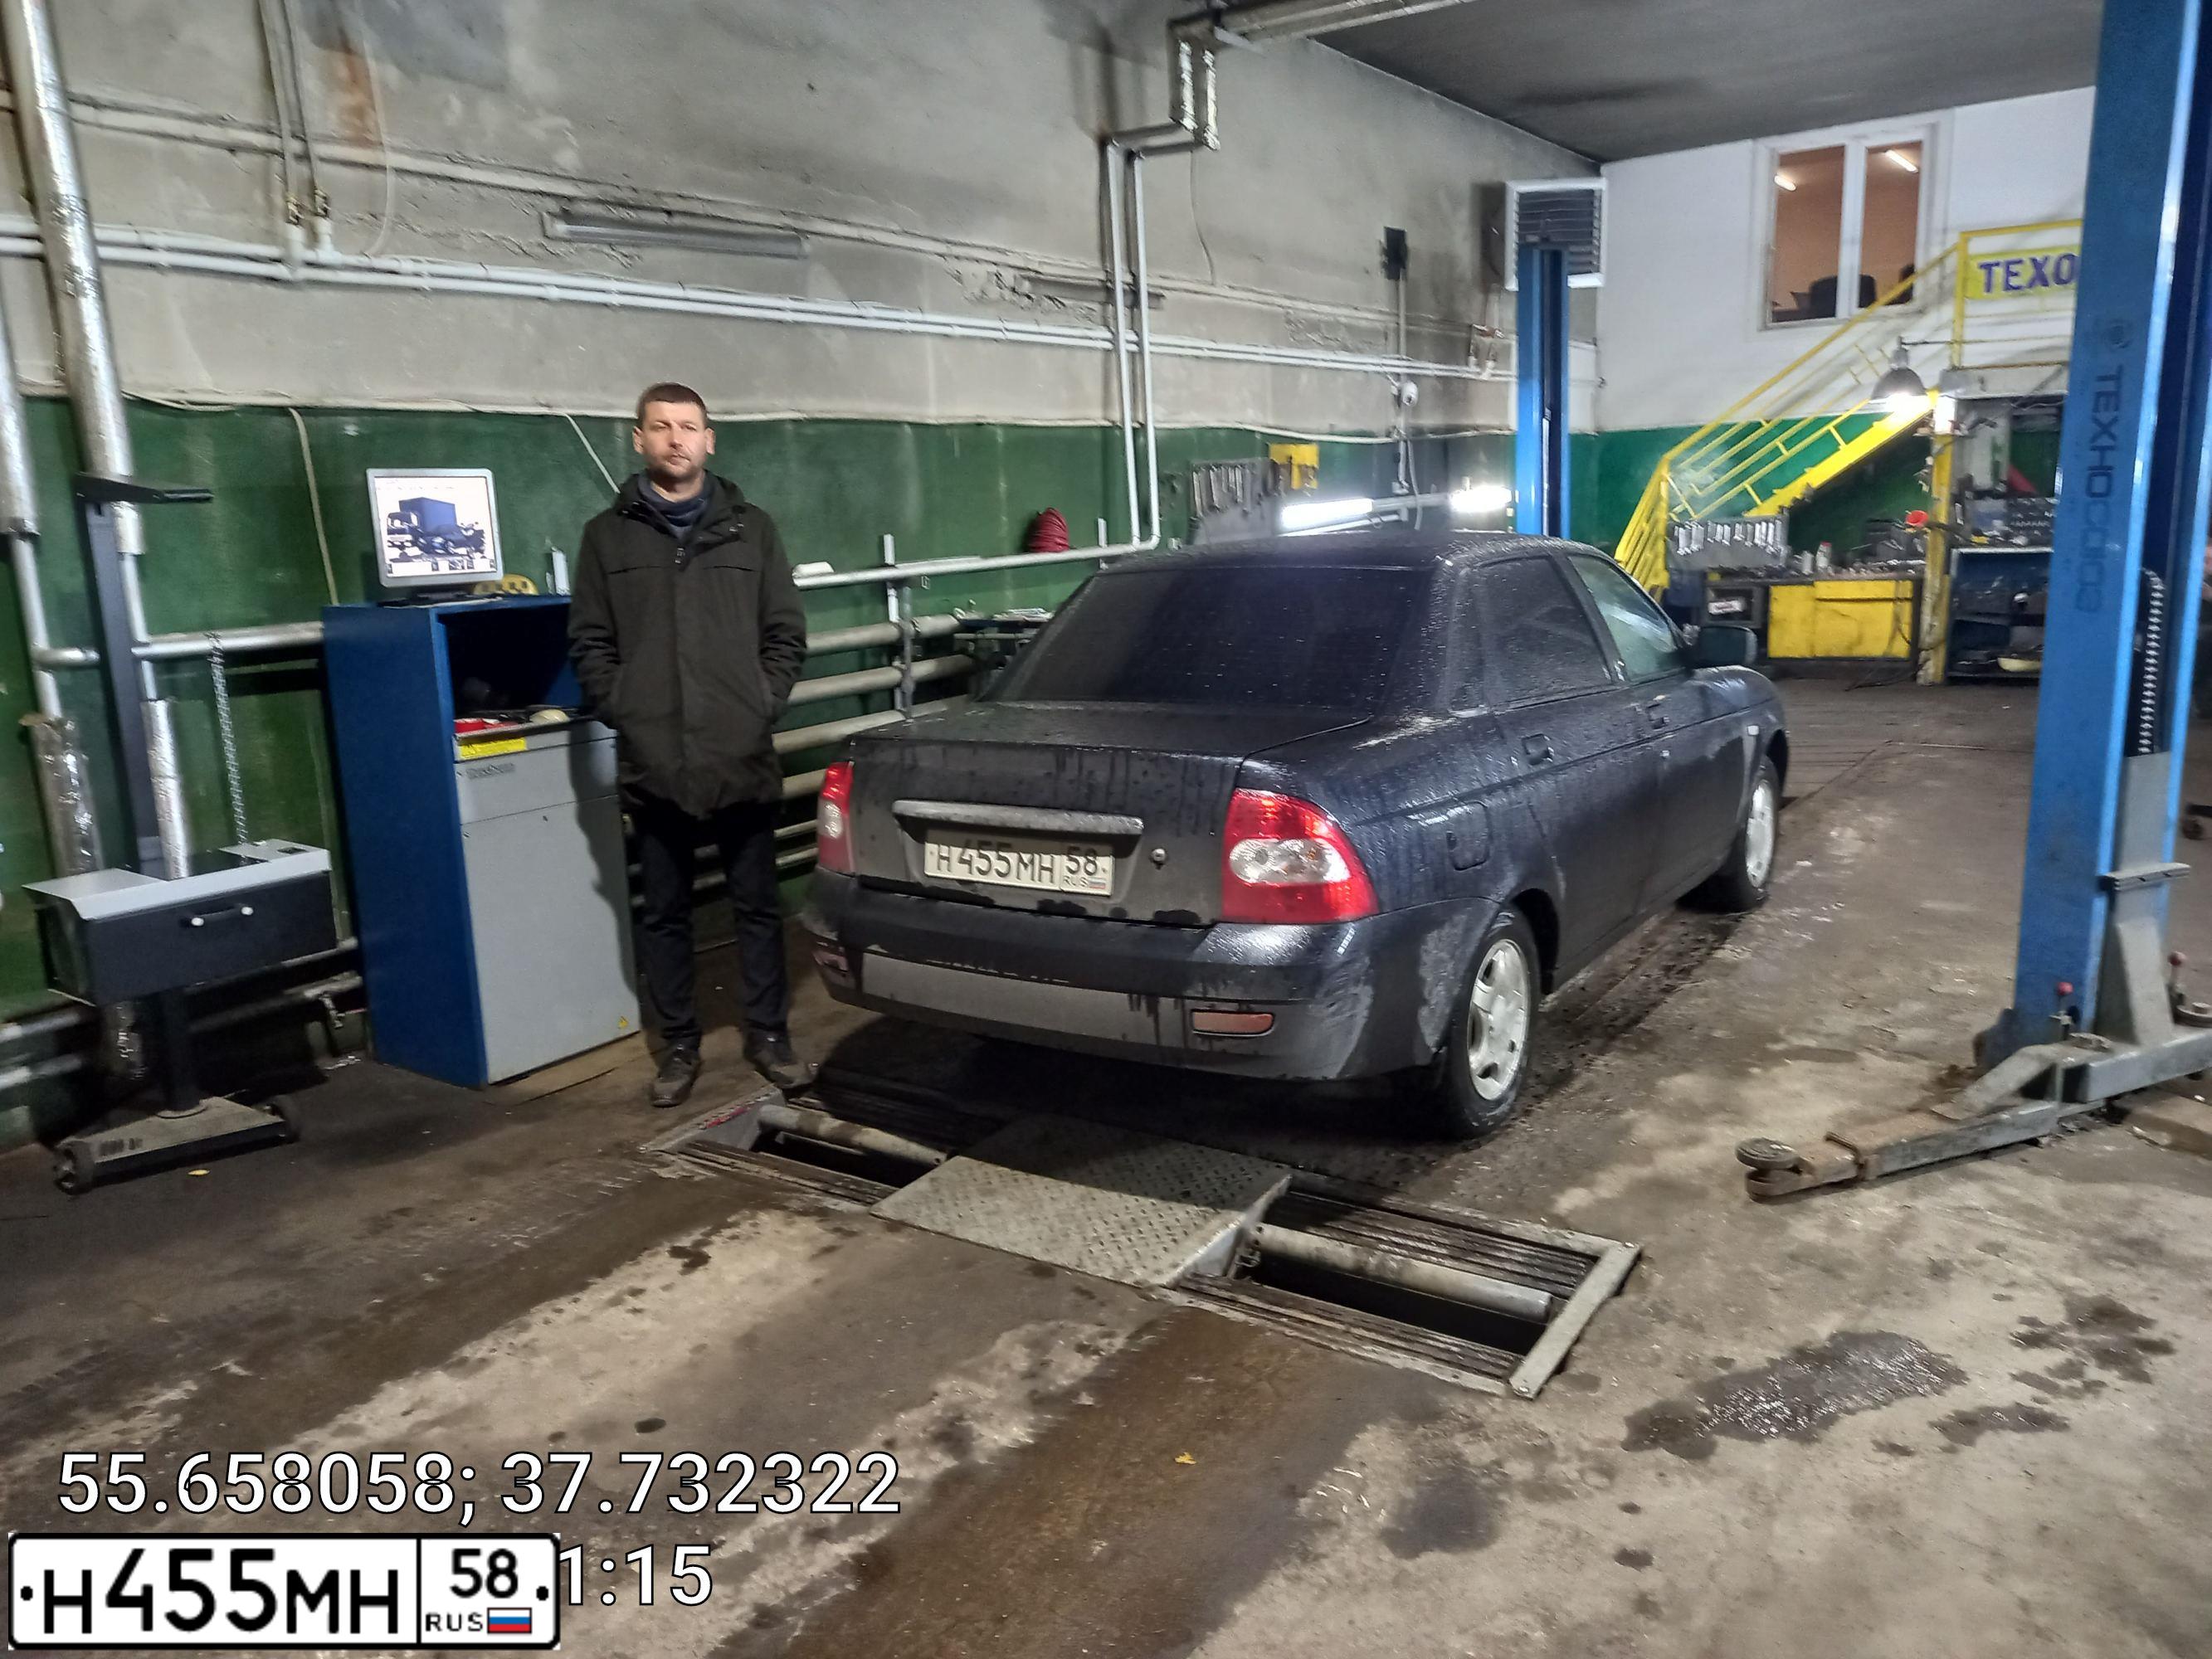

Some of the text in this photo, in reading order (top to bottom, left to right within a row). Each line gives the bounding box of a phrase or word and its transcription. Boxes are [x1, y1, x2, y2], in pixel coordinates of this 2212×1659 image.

[1978, 252, 2081, 294] ТЕХО
[937, 839, 1099, 884] Н455МН 58
